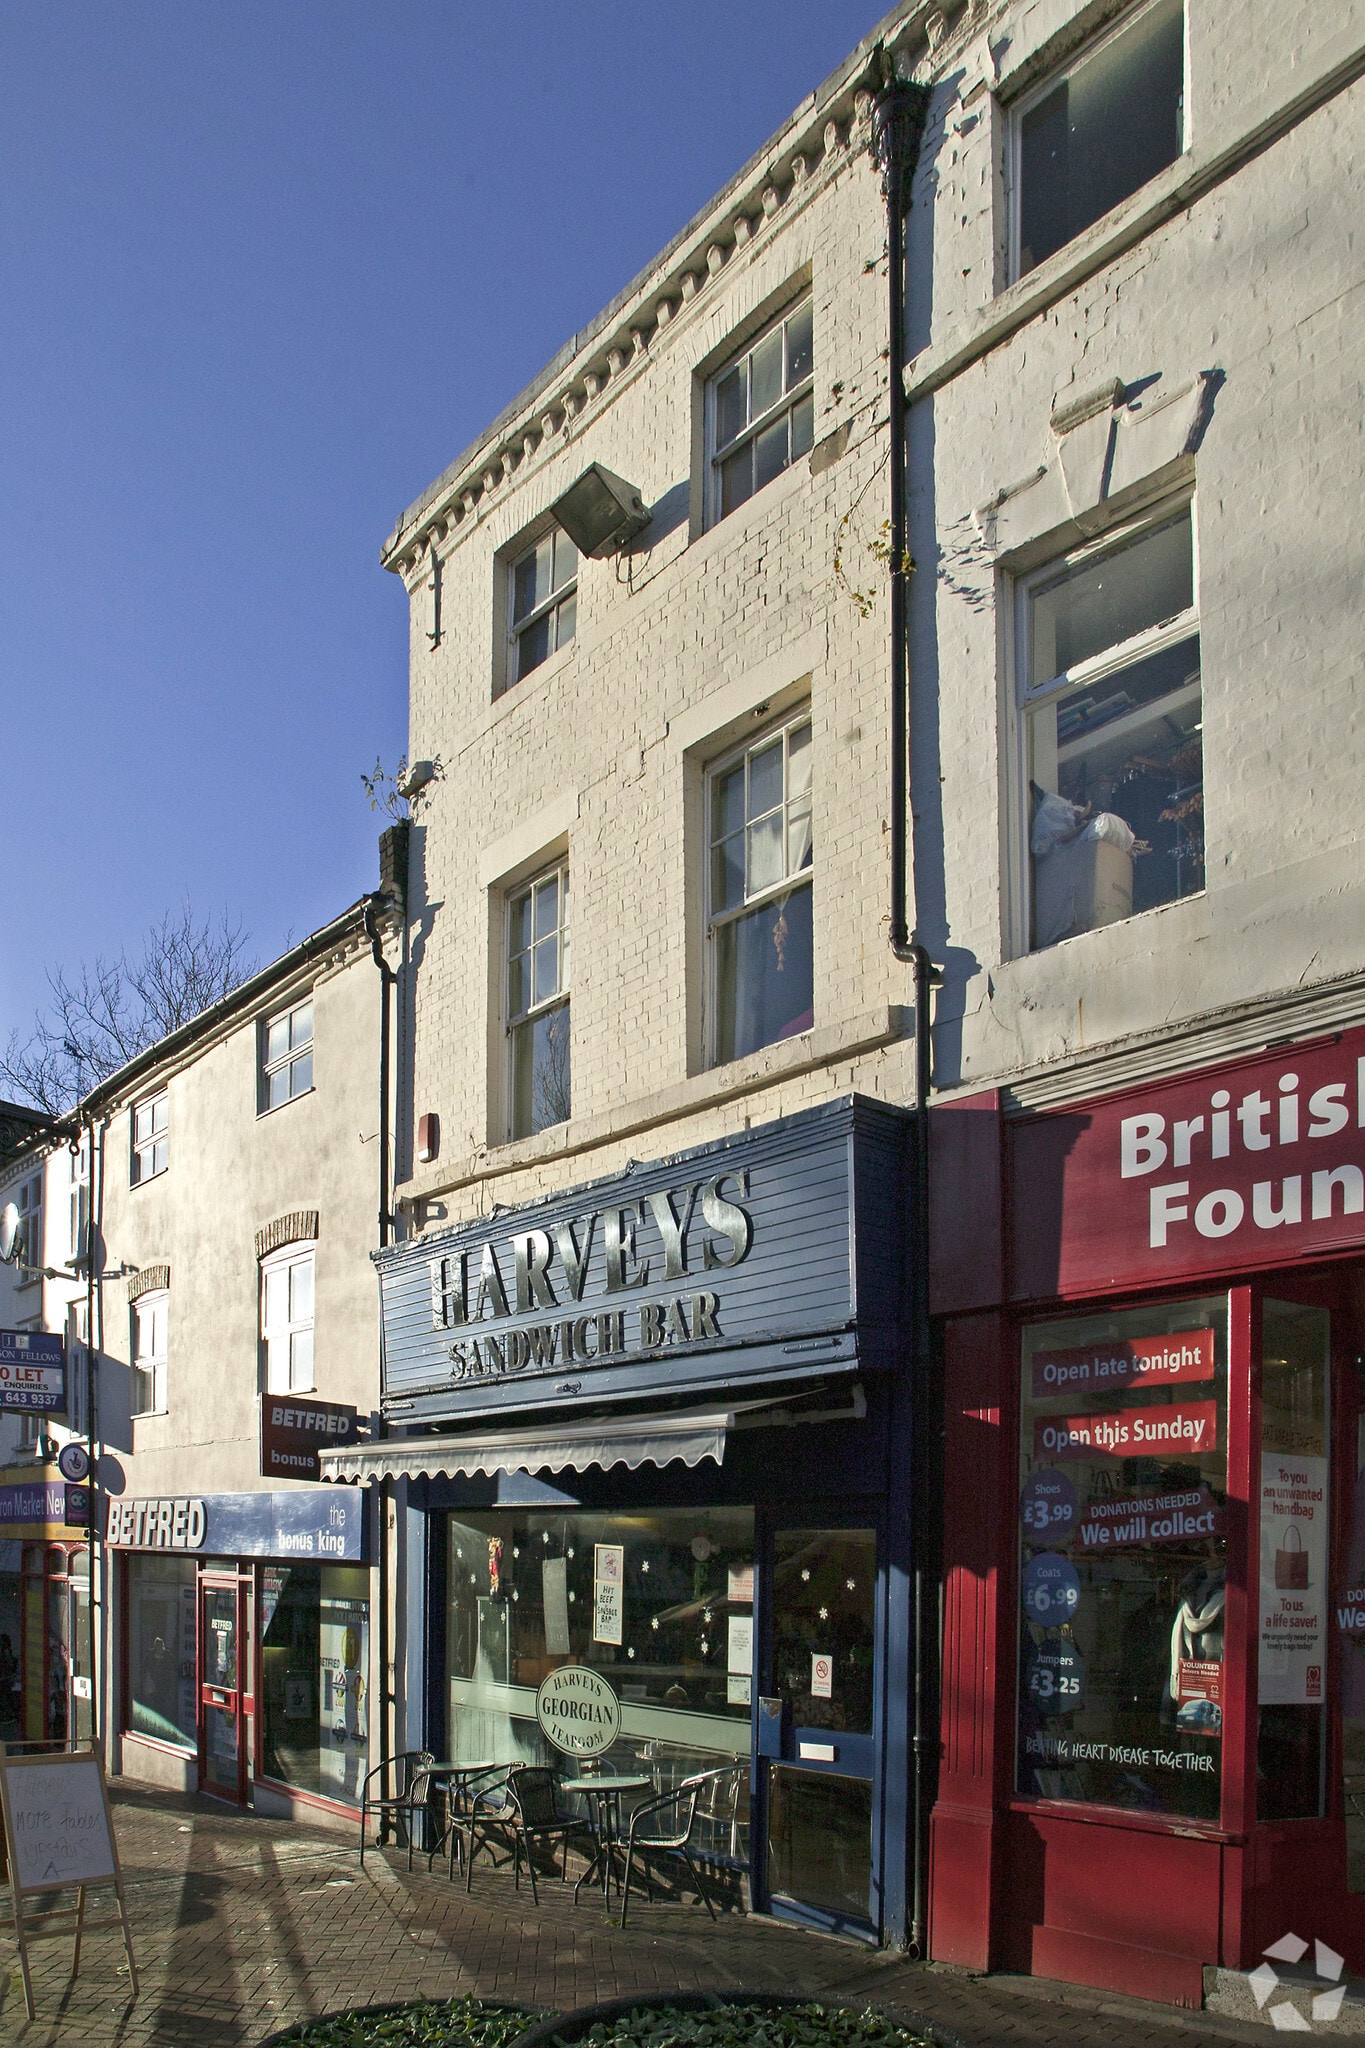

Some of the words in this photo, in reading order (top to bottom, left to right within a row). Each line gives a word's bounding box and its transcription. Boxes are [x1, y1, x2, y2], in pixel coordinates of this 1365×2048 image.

[1149, 1164, 1364, 1249] Foun
[426, 1168, 754, 1331] HARVEYS
[448, 1309, 628, 1380] SANDWICH
[638, 1291, 724, 1350] BAR
[21, 1352, 61, 1361] FELLOWS
[1043, 1363, 1090, 1385] Open
[1094, 1358, 1128, 1377] late
[1131, 1346, 1202, 1373] tonight
[4, 1381, 49, 1390] ENQUIRIES
[15, 1367, 44, 1382] LET
[5, 1392, 27, 1403] 643
[31, 1393, 58, 1405] 9337
[271, 1406, 350, 1434] BETFRED
[1042, 1427, 1091, 1452] Open
[1095, 1420, 1129, 1445] this
[1133, 1415, 1206, 1443] Sunday
[271, 1449, 315, 1468] bonus
[1278, 1469, 1289, 1483] To
[1290, 1473, 1308, 1486] you
[1034, 1484, 1061, 1495] Shoes
[1263, 1487, 1275, 1497] an
[1276, 1487, 1323, 1502] unwanted
[14, 1491, 45, 1516] Market
[1023, 1500, 1073, 1528] £3.99
[1090, 1498, 1154, 1519] DONATIONS
[1155, 1492, 1201, 1510] NEEDED
[1272, 1500, 1314, 1521] handbag
[107, 1499, 207, 1548] BETFRED
[329, 1505, 346, 1527] the
[1081, 1523, 1110, 1545] We
[1113, 1517, 1147, 1542] will
[1150, 1511, 1215, 1538] collect
[278, 1529, 313, 1551] bonus
[318, 1529, 345, 1556] king
[1037, 1567, 1061, 1578] Coats
[599, 1594, 614, 1604] BEEF
[1026, 1583, 1078, 1612] £6.99
[1280, 1598, 1291, 1612] To
[1293, 1601, 1304, 1612] us
[1347, 1589, 1365, 1602] DO
[211, 1618, 233, 1631] BETFRED
[1265, 1617, 1272, 1627] a
[1273, 1614, 1288, 1628] life
[1289, 1614, 1318, 1628] saver!
[1037, 1653, 1074, 1667] Jumpers
[1182, 1662, 1220, 1671] VOLUNTEER
[553, 1673, 603, 1697] HARVEYS
[1031, 1669, 1080, 1697] £3.25
[542, 1696, 614, 1725] GEORGIAN
[1026, 1736, 1069, 1757] BEATING
[1072, 1743, 1109, 1760] HEART
[1109, 1745, 1150, 1765] DISEASE
